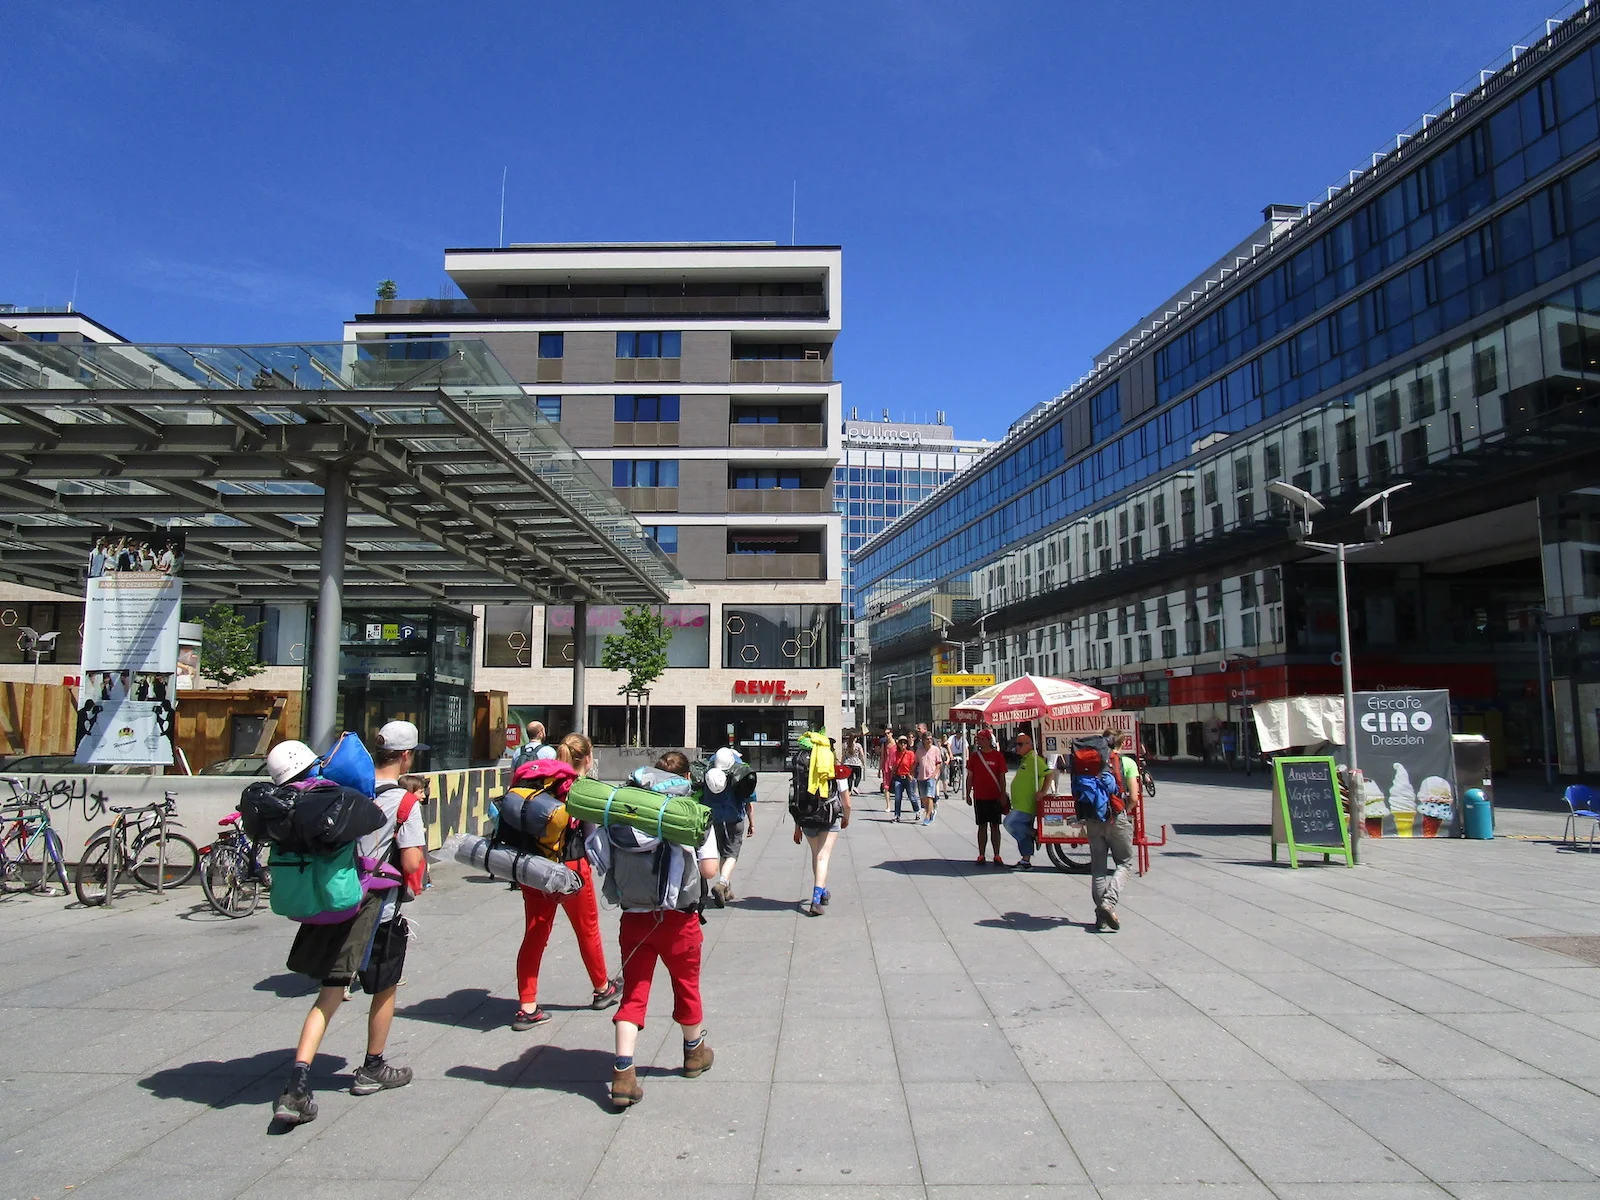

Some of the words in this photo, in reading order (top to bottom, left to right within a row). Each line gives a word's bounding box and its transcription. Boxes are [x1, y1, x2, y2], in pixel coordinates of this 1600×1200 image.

[848, 426, 921, 442] pullman
[734, 680, 787, 695] REWE
[1367, 694, 1422, 710] Eiscafe
[991, 712, 999, 722] 22
[999, 707, 1040, 721] HALTESTELLEN
[1051, 703, 1094, 717] STADTRUNDFAHRT
[1044, 715, 1132, 731] STADTRUNDFAHRT
[1360, 711, 1433, 732] CIAO
[1371, 734, 1425, 746] Dresden
